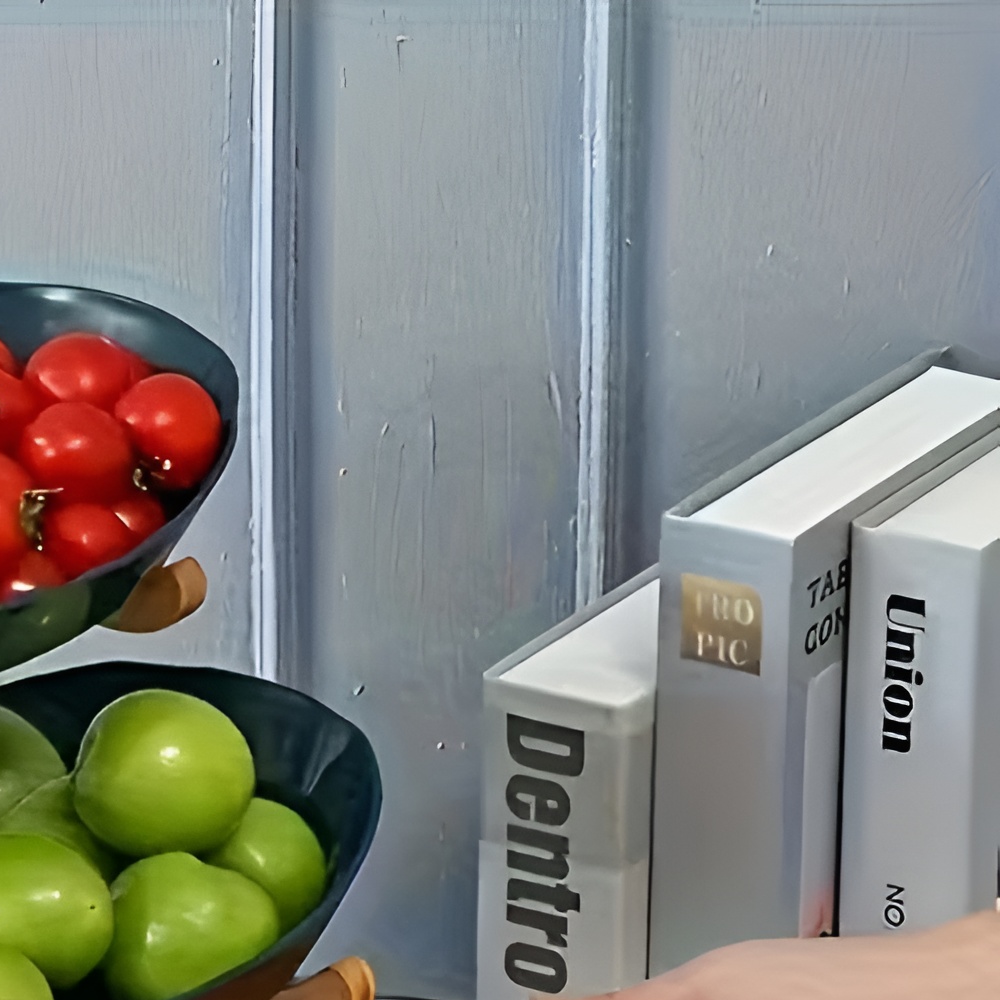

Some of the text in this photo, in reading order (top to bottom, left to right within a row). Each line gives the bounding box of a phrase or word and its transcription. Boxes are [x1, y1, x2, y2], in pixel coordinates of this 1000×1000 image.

[697, 631, 748, 666] PIC
[882, 594, 926, 753] Union
[505, 712, 585, 994] Dentro
